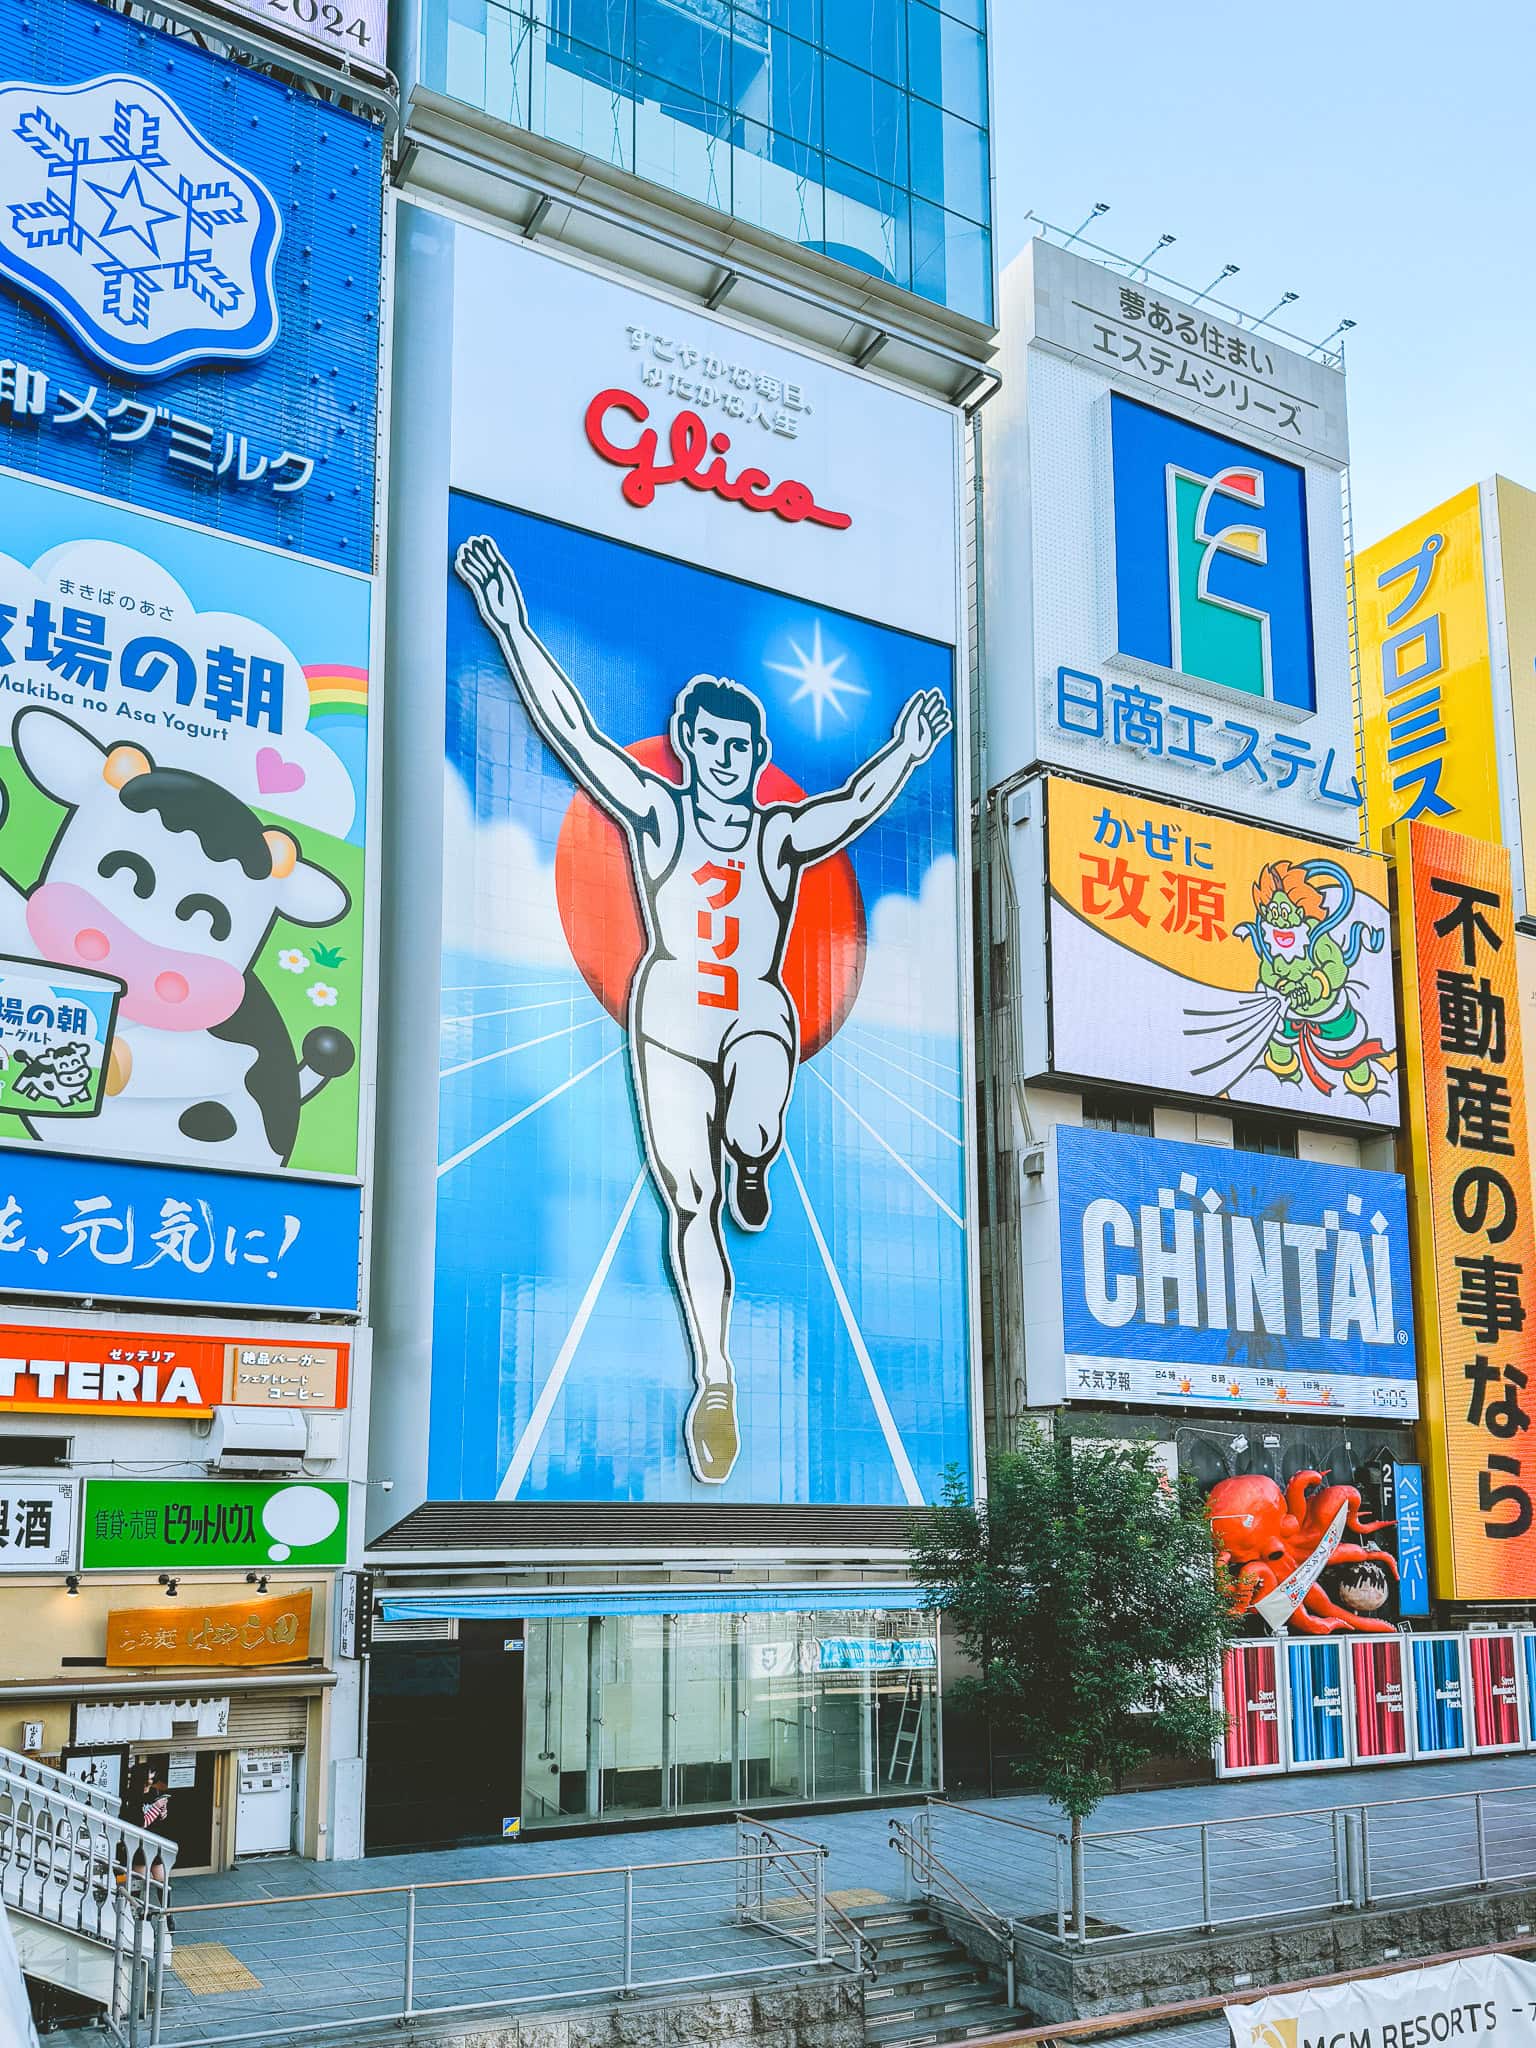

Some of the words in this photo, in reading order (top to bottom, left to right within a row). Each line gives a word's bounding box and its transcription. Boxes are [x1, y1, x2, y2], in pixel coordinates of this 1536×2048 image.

[1119, 286, 1275, 376] 夢ある住まい
[626, 326, 815, 415] すこやかな毎日、
[1093, 324, 1302, 435] エステムシリーズ
[585, 389, 852, 529] Glico
[59, 579, 175, 622] まきばのあさ
[0, 598, 285, 736] 場の朝
[1378, 533, 1457, 822] プロミス
[82, 697, 108, 713] no
[116, 702, 156, 724] Asa
[163, 711, 229, 741] Yogurt
[1056, 665, 1362, 808] 日商エステム
[1093, 808, 1214, 870] かぜに
[1079, 852, 1229, 942] 改源
[691, 859, 745, 1011] グリコ
[1432, 876, 1533, 1538] 不動産の事なら
[109, 1349, 175, 1363] ゼッテリア
[240, 1374, 308, 1385] フェアトレード
[242, 1352, 327, 1366] 絶品バーガー
[269, 1388, 325, 1399] コーヒー
[1078, 1369, 1131, 1391] 天気予報
[1383, 1464, 1392, 1505] 2F
[0, 1499, 53, 1549] 酒
[164, 1503, 257, 1544] ピタットハウス
[1399, 1477, 1423, 1600] ペンギンバー
